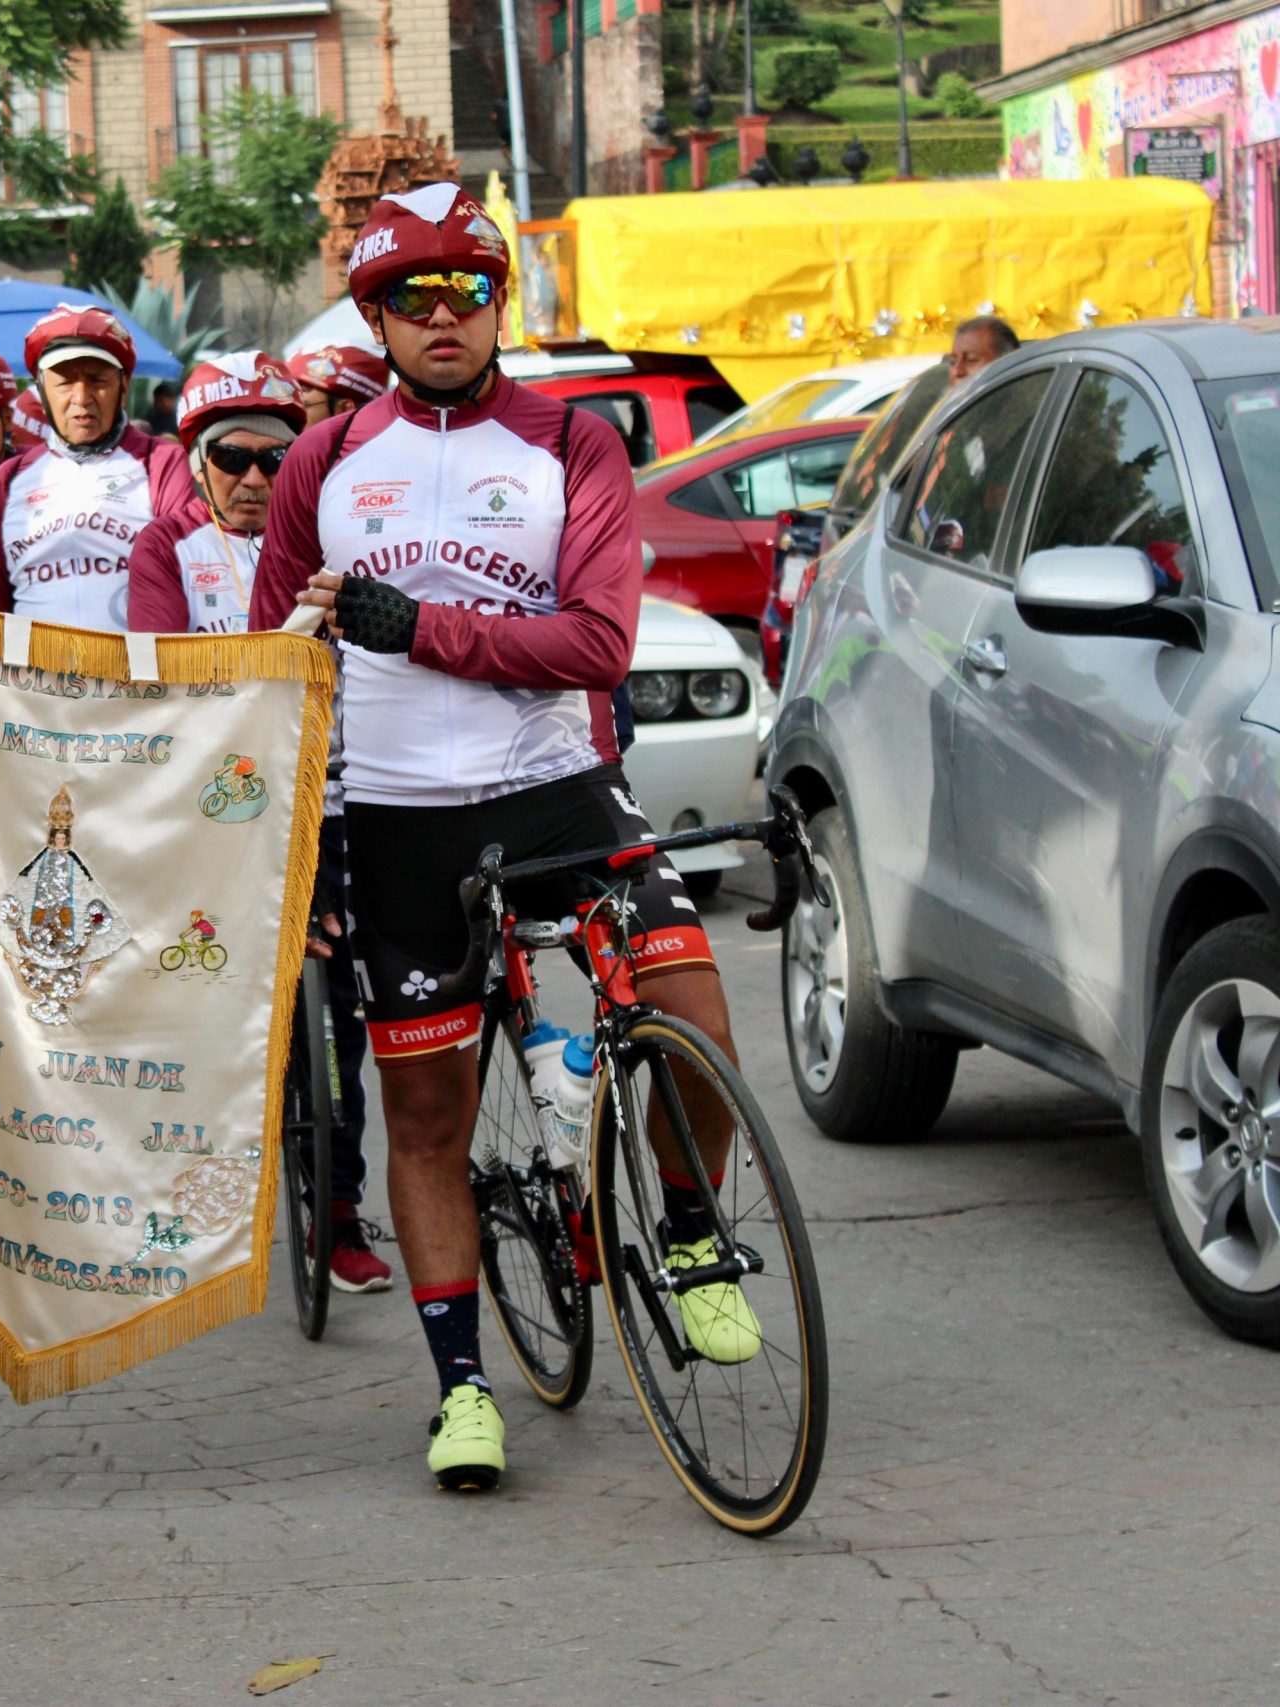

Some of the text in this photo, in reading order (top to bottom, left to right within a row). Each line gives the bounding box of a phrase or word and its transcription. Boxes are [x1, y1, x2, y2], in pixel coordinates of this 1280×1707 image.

[362, 228, 399, 264] MÉX.
[188, 385, 204, 412] DE
[204, 376, 250, 404] MÉX.
[356, 495, 393, 508] ACM
[388, 1017, 468, 1045] Emirates
[37, 1049, 130, 1089] JUAN
[136, 1059, 186, 1093] DE
